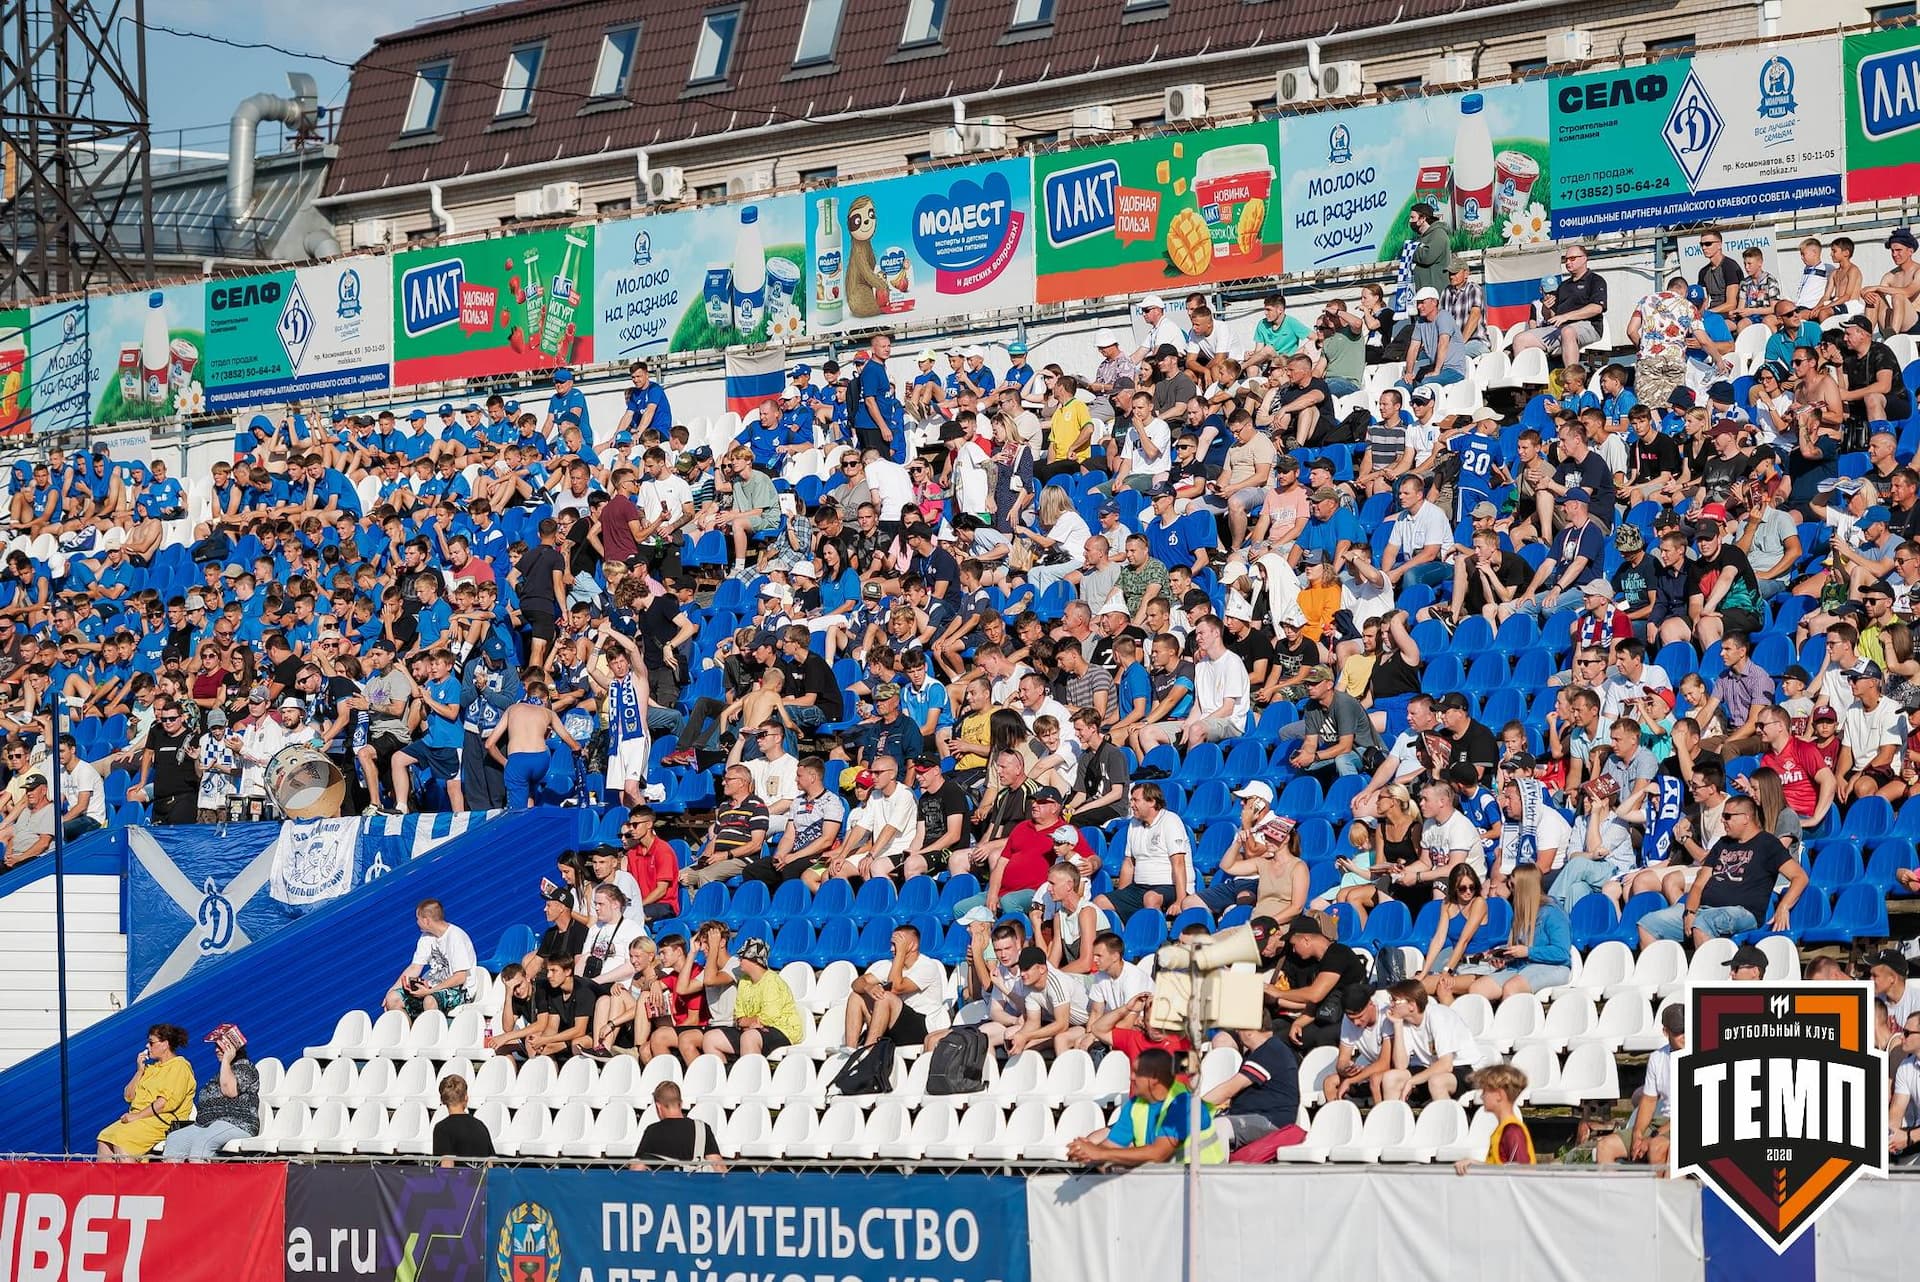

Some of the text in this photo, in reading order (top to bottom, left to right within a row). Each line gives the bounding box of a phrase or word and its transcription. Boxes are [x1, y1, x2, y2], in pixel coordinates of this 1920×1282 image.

[1558, 74, 1668, 114] СЕЛФ
[1559, 119, 1618, 134] Строительная
[1559, 132, 1600, 143] компания
[1723, 163, 1734, 173] пр.
[1802, 149, 1835, 161] 50-11-05
[1759, 166, 1798, 177] molskaz.ru
[1307, 166, 1376, 200] Молоко
[1560, 167, 1634, 184] отдел продаж
[1056, 170, 1116, 232] ЛАКТ
[1213, 186, 1250, 202] НОВИНКА
[1560, 177, 1670, 201] +7 (3852) 50-64-24
[1118, 194, 1157, 213] УДОБНАЯ
[1295, 189, 1388, 229] на разные
[1559, 185, 1836, 228] ОФИЦИАЛЬНЫЕ ПАРТНЕРЫ АЛТАЙСКОГО КРАЕВОГО СОВЕТА «ДИНАМО»
[919, 200, 1005, 237] МОДЕСТ
[1118, 215, 1151, 233] ПОЛЬЗА
[1313, 221, 1374, 250] «хочу»
[1724, 236, 1770, 252] ТРИБУНА
[963, 266, 993, 287] детских
[991, 220, 1020, 270] вопросах!
[615, 268, 670, 297] Молоко
[211, 282, 281, 311] СЕЛФ
[410, 268, 461, 323] ЛАКТ
[463, 290, 495, 308] УДОБНАЯ
[605, 289, 678, 323] на разные
[461, 308, 489, 325] ПОЛЬЗА
[618, 317, 667, 342] «хочу»
[40, 381, 55, 397] на
[310, 378, 336, 390] КРАЕВОГО
[336, 376, 357, 386] СОВЕТА
[1462, 449, 1491, 476] 20
[601, 1201, 980, 1262] ПРАВИТЕЛЬСТВО
